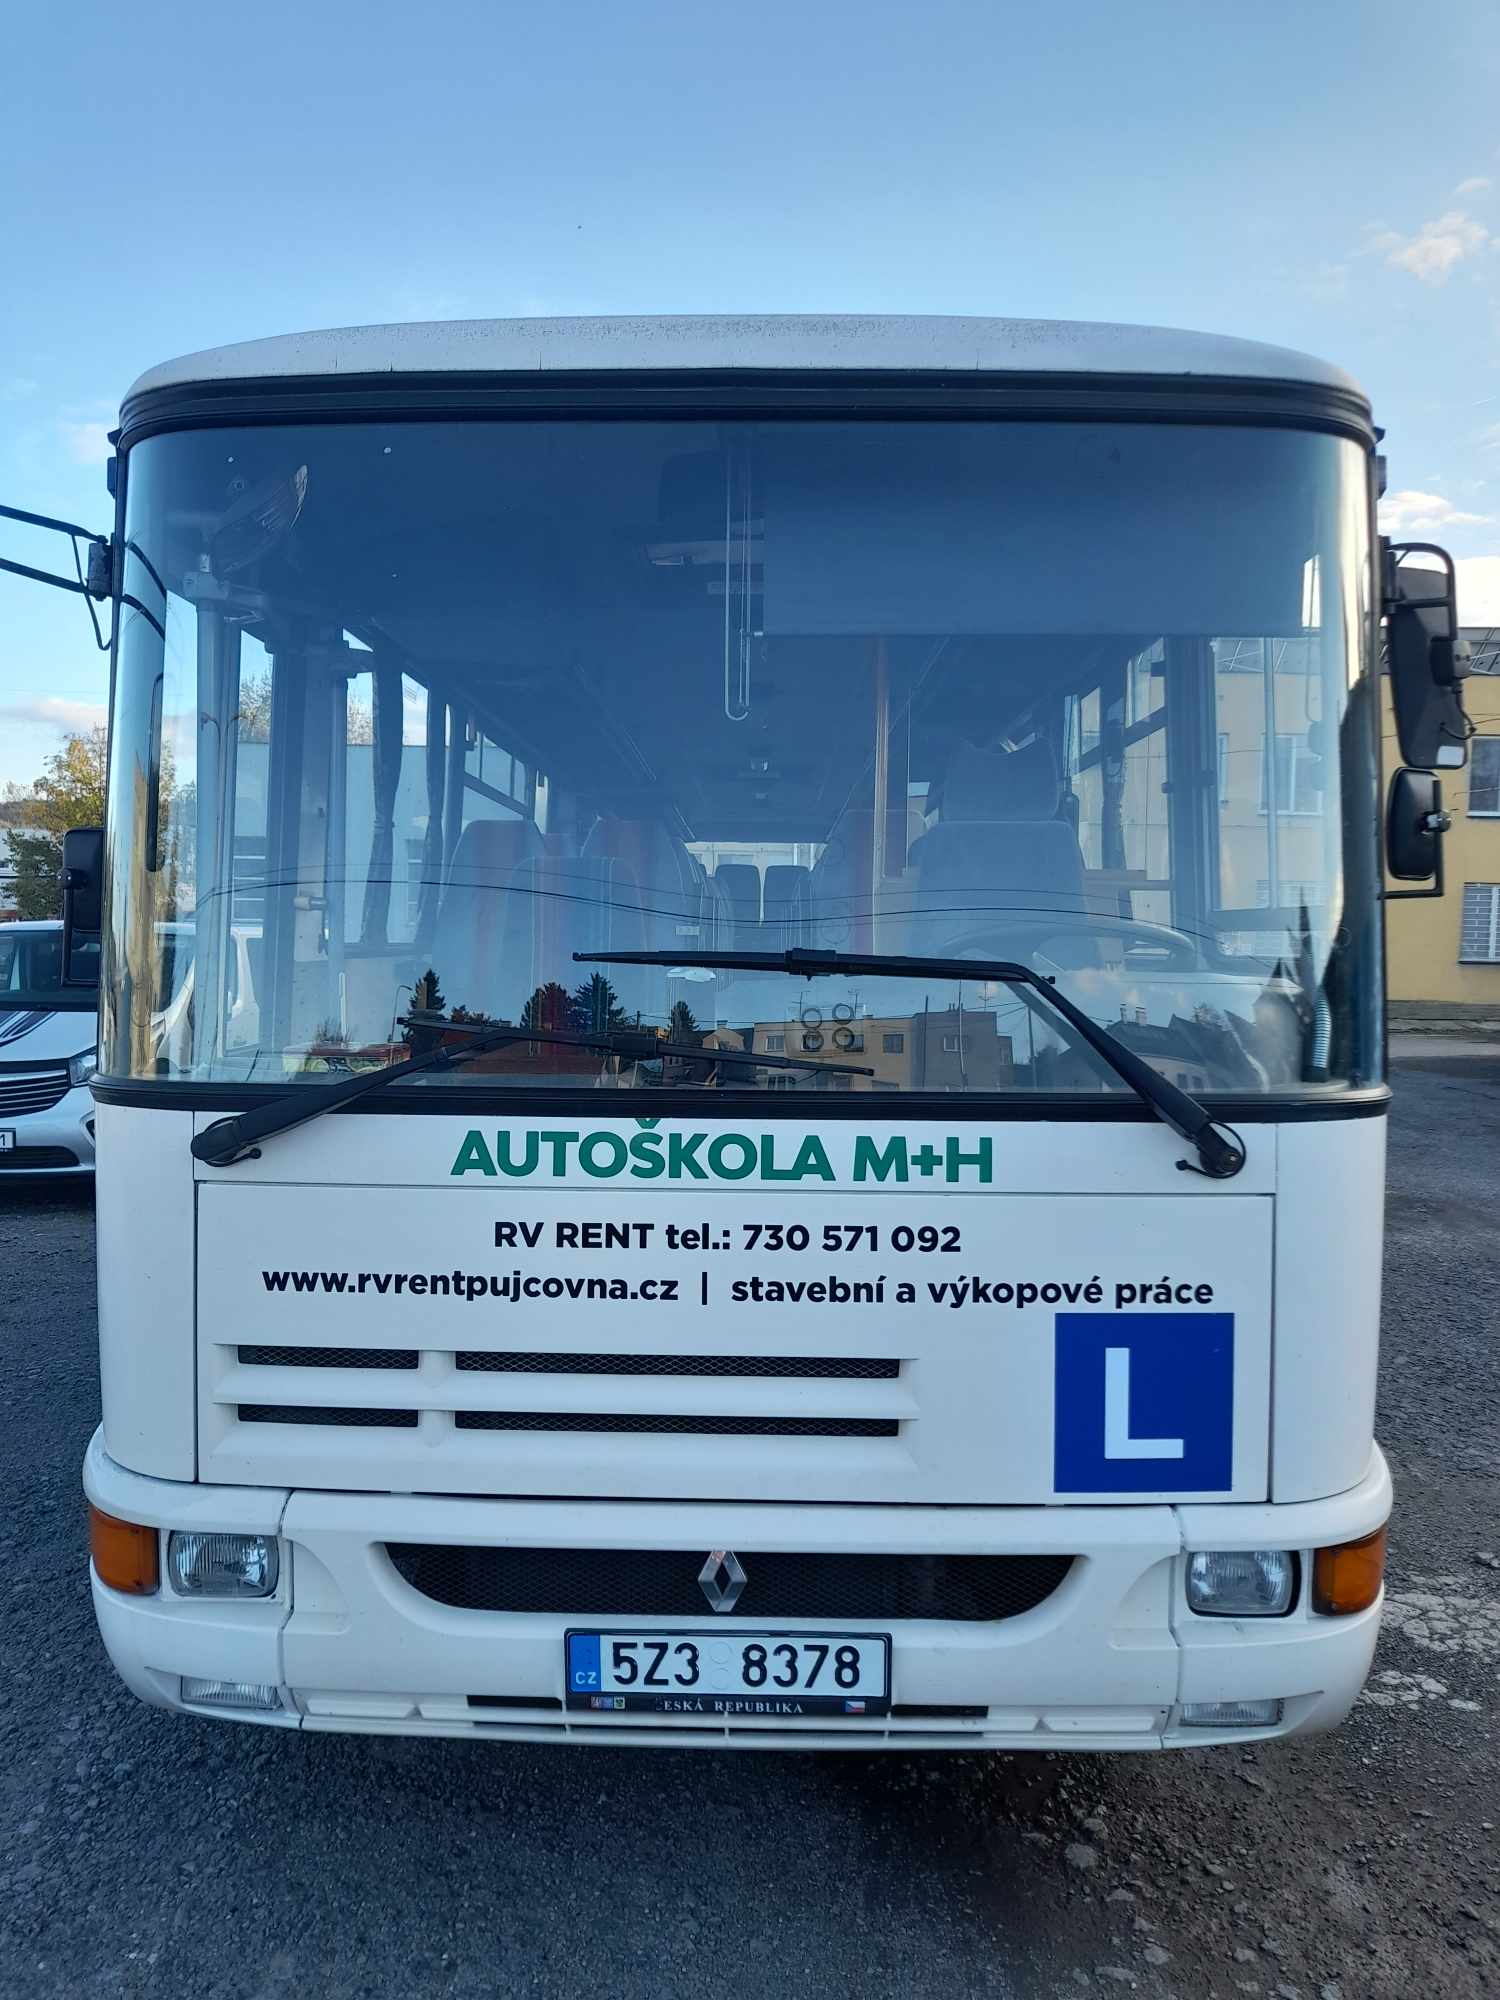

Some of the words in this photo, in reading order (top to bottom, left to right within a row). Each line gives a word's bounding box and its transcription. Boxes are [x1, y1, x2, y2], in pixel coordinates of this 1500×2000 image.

[450, 1118, 836, 1181] AUTOŠKOLA
[853, 1135, 992, 1183] M+H
[495, 1221, 544, 1248] RV
[556, 1222, 654, 1249] RENT
[666, 1223, 730, 1251] tel.:
[743, 1224, 809, 1252] 730
[822, 1225, 878, 1252] 571
[891, 1225, 961, 1253] 092
[262, 1270, 678, 1303] www.rvrentpujcovna.cz
[732, 1275, 887, 1304] stavební
[896, 1282, 915, 1304] a
[928, 1275, 1103, 1309] výkopové
[1116, 1275, 1213, 1310] práce
[1105, 1347, 1184, 1460] L
[576, 1671, 597, 1685] CZ
[612, 1641, 700, 1687] 5Z3
[742, 1643, 861, 1689] 8378
[714, 1700, 804, 1714] REPUBLIKA
